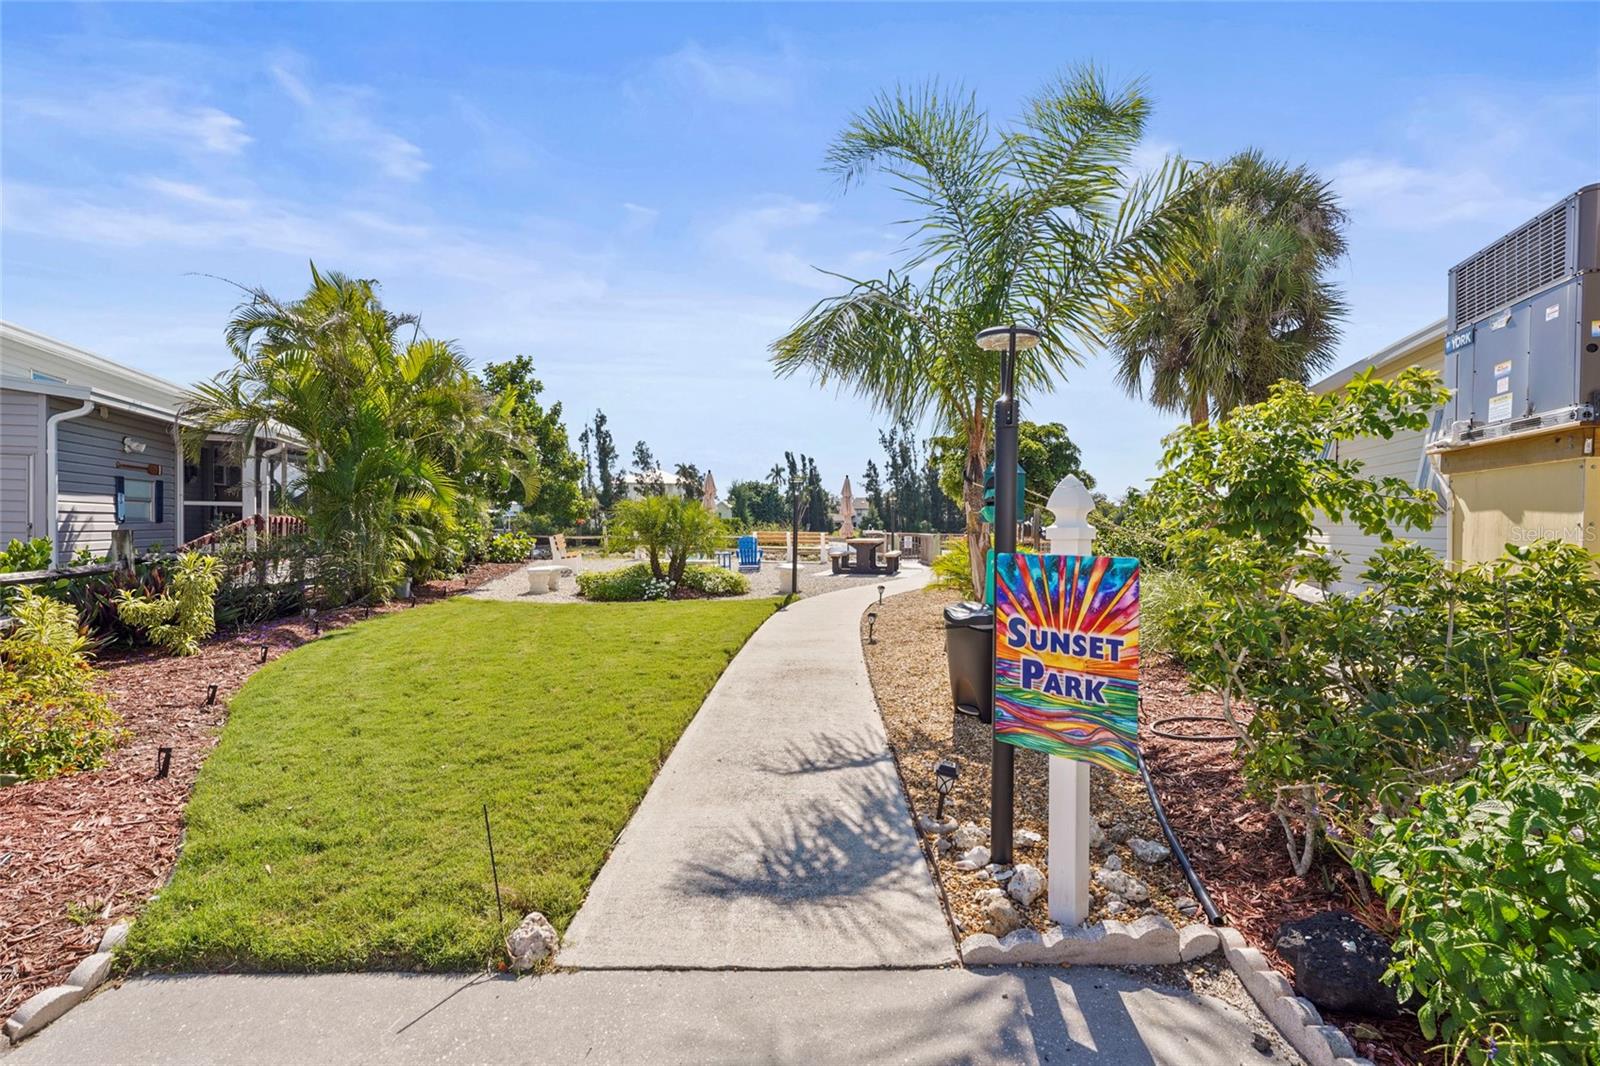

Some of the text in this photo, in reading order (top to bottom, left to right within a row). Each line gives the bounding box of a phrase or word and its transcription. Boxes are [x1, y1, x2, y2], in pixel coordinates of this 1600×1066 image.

[1451, 331, 1471, 349] YORK
[1007, 616, 1124, 662] SUNSET
[1021, 658, 1106, 704] PARK
